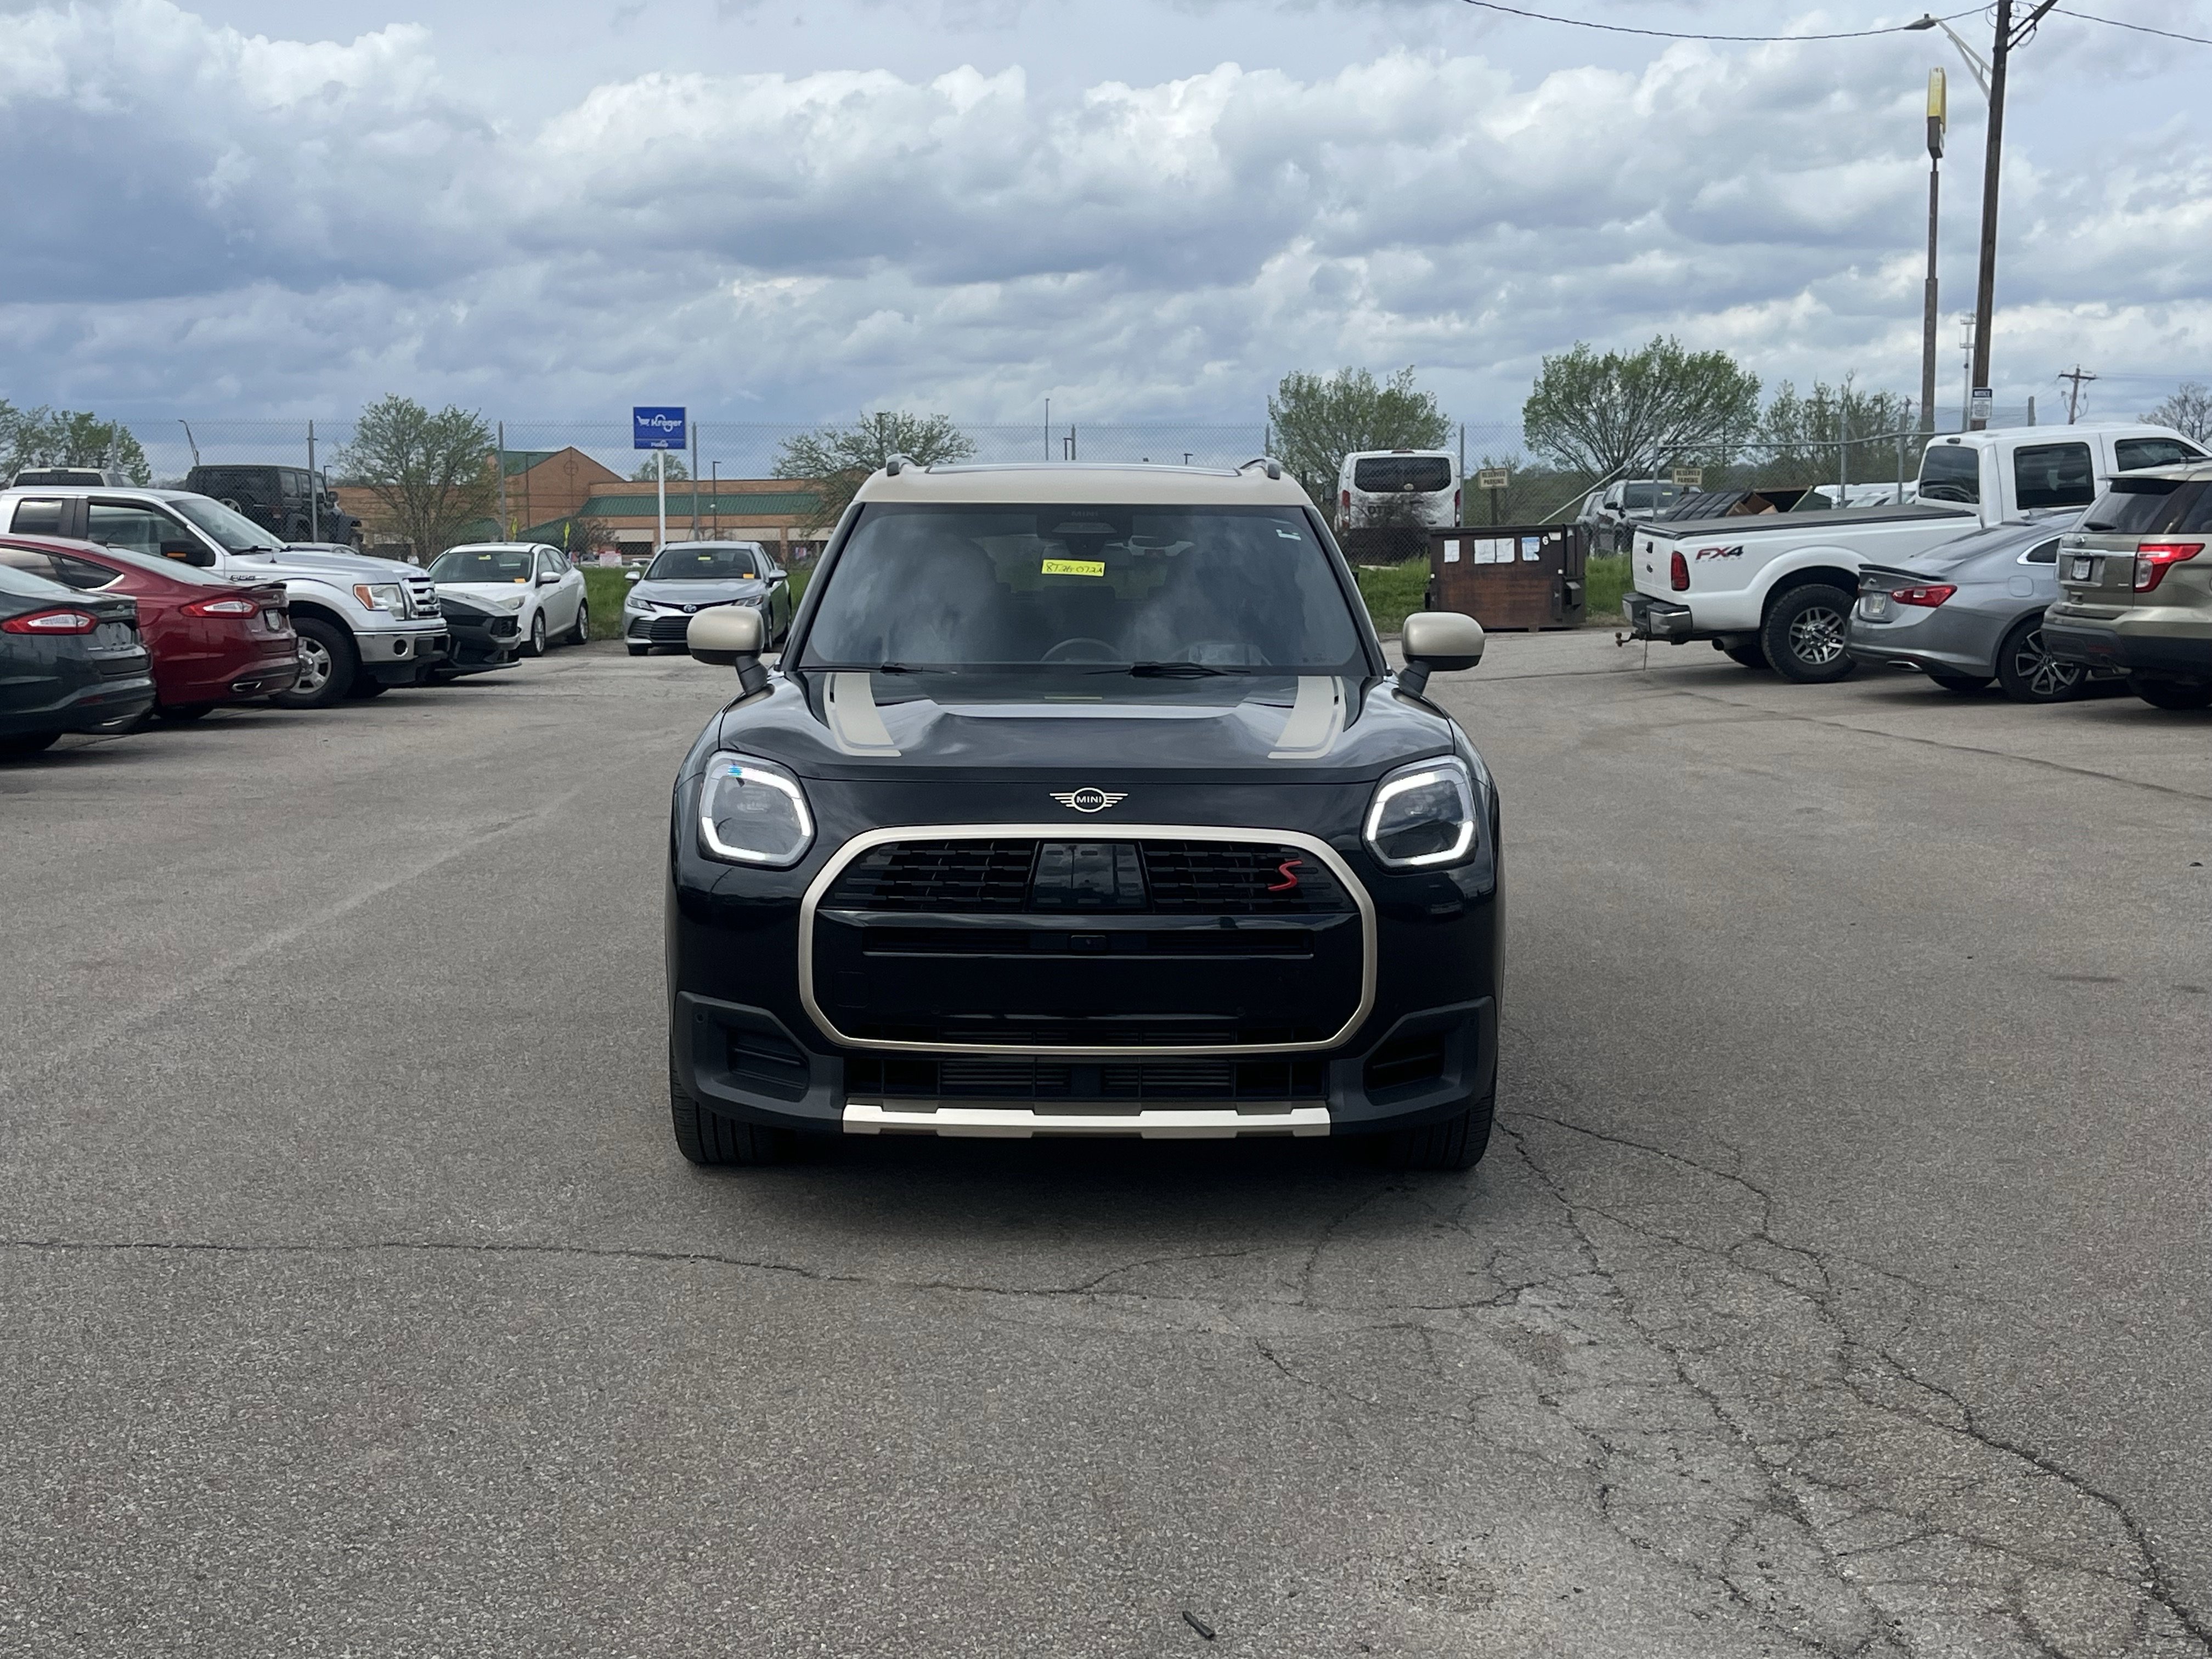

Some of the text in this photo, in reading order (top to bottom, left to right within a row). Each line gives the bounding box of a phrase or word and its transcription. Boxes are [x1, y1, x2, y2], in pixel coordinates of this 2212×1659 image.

[651, 414, 682, 433] Kroger
[1695, 545, 1744, 560] FX4
[1076, 795, 1102, 804] MINI
[1267, 860, 1303, 891] S
